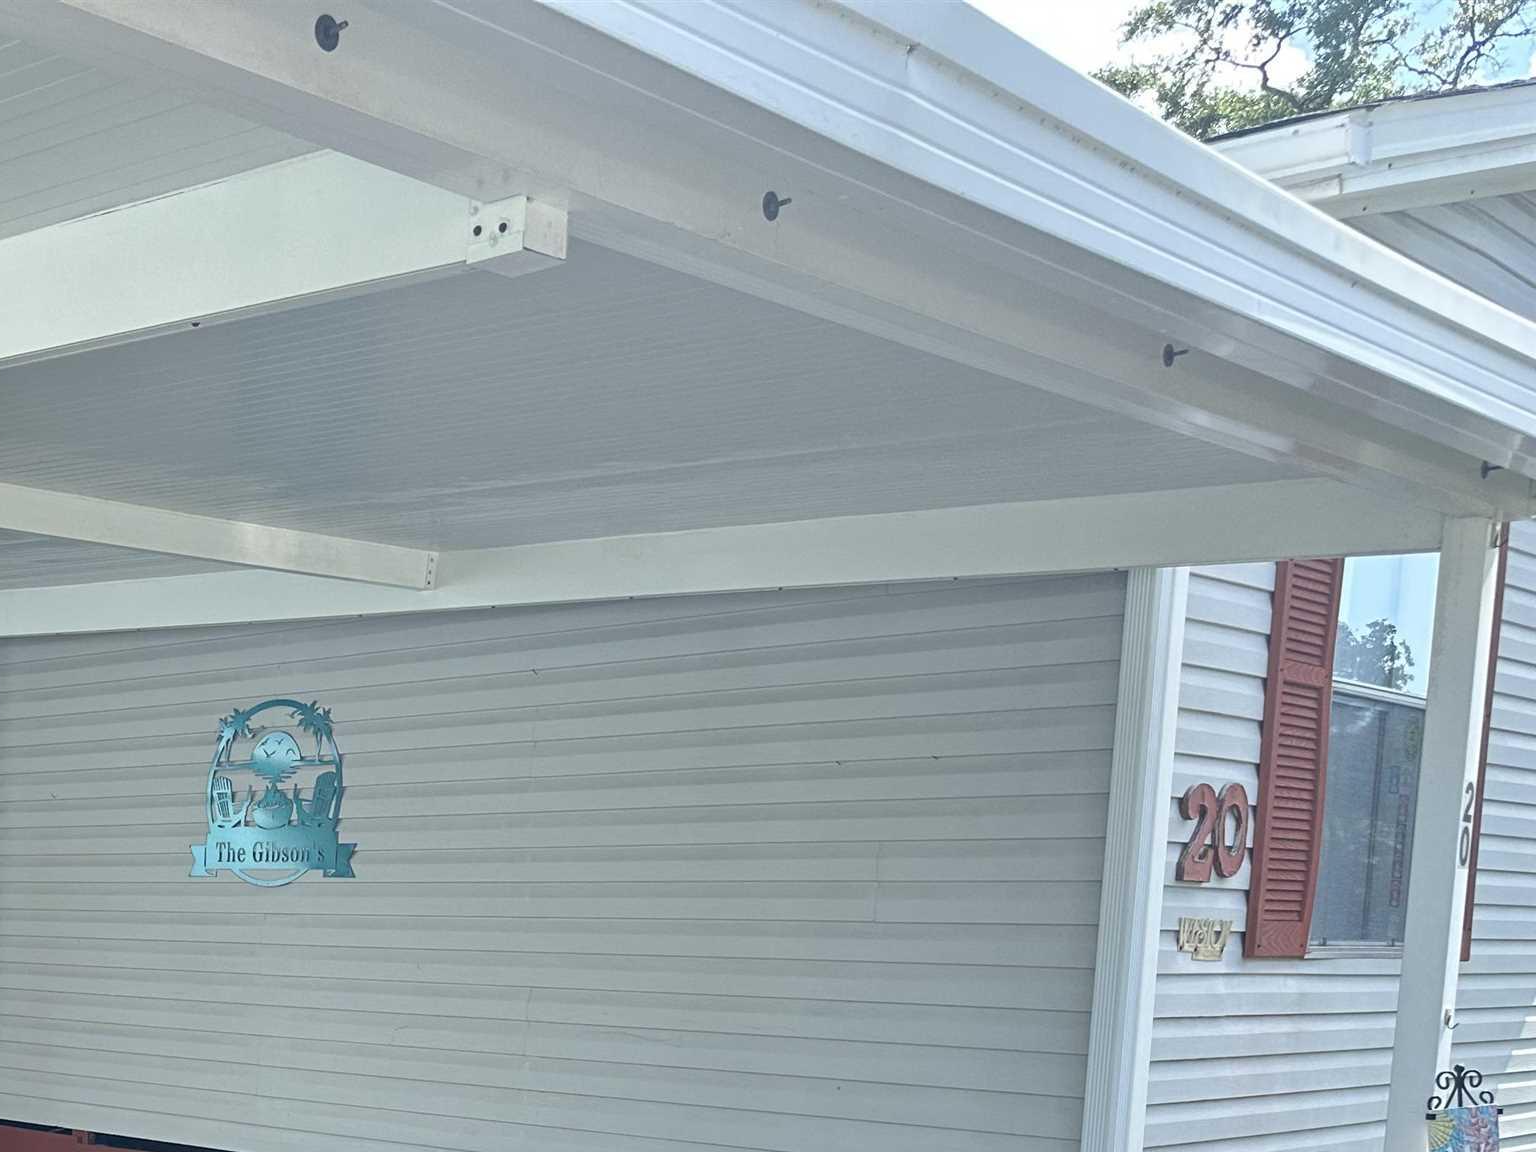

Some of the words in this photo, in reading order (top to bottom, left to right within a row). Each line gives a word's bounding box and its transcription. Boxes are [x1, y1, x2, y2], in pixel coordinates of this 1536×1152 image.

[215, 841, 246, 863] The
[252, 841, 325, 863] Gibson's
[1175, 782, 1249, 882] 20
[1459, 781, 1474, 866] 20
